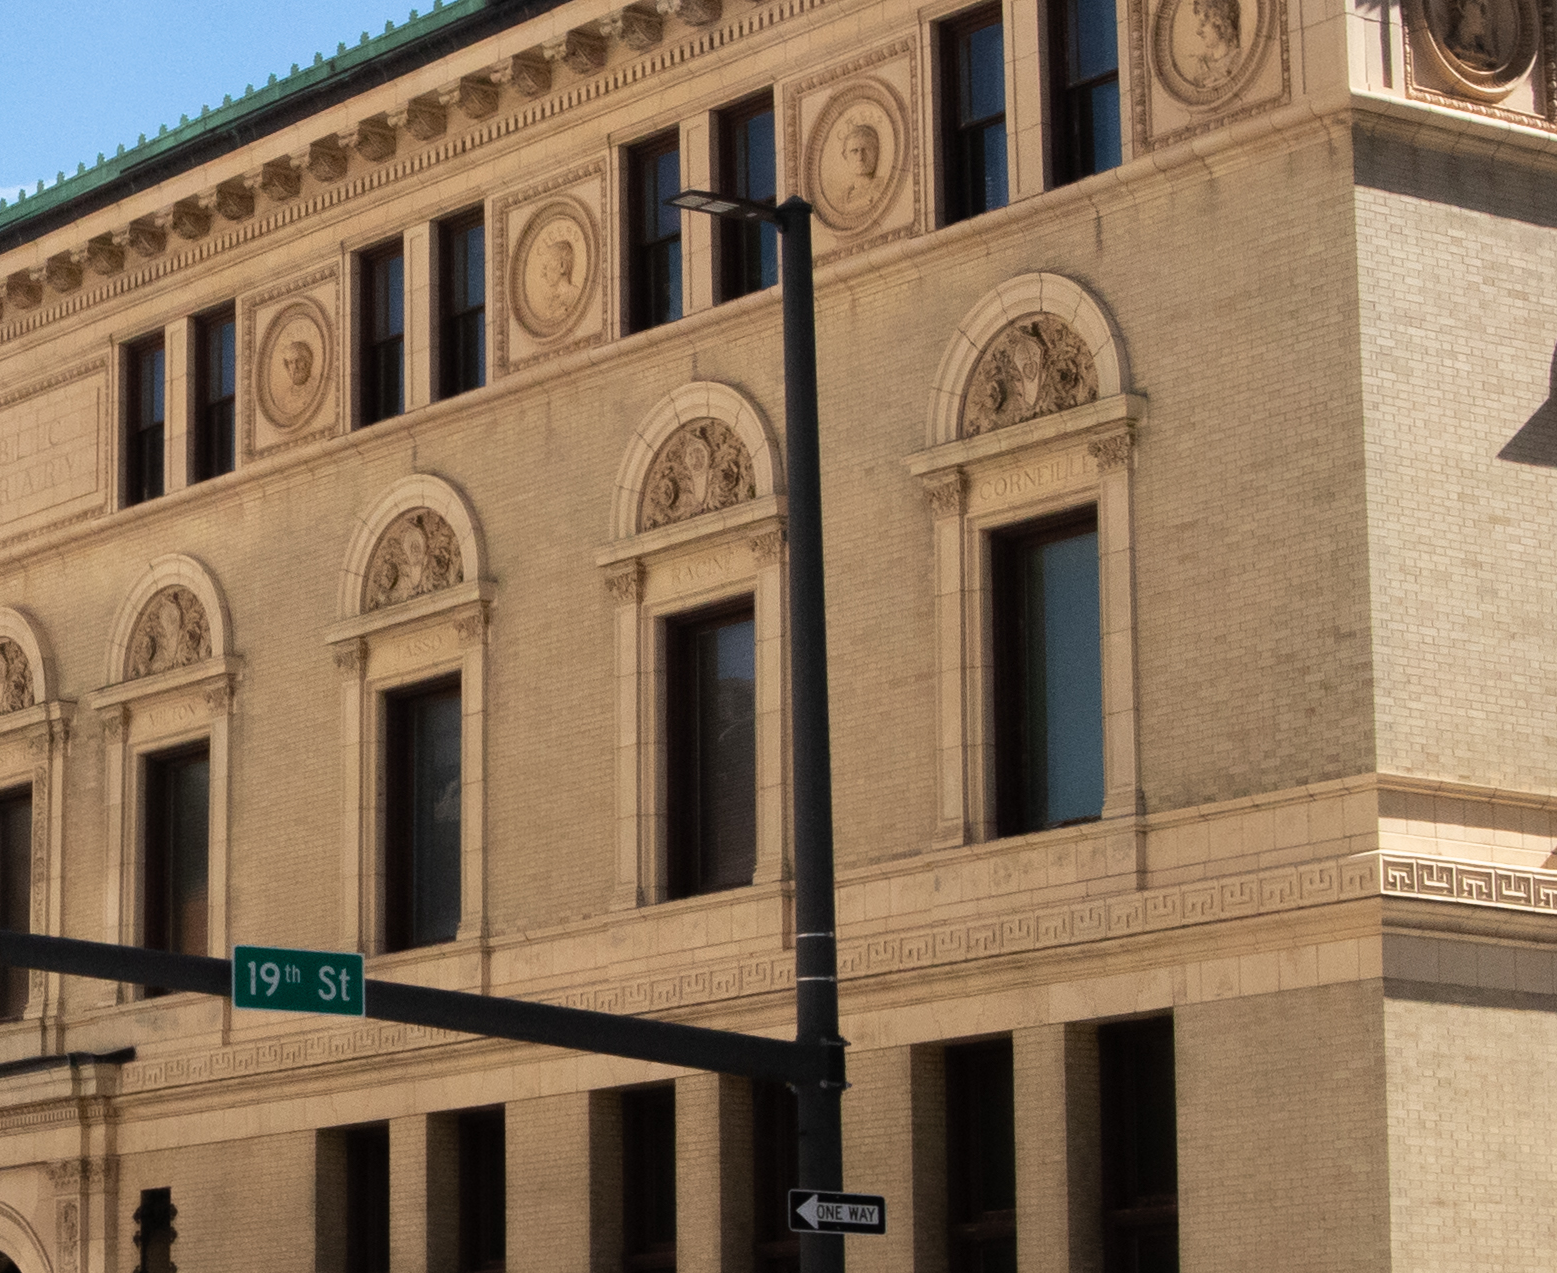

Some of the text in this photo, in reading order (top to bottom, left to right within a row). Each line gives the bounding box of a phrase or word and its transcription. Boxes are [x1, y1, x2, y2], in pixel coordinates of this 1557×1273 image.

[979, 454, 1094, 501] CORNEILLE
[248, 961, 351, 1001] 19th St
[817, 1204, 876, 1223] ONE WAY
